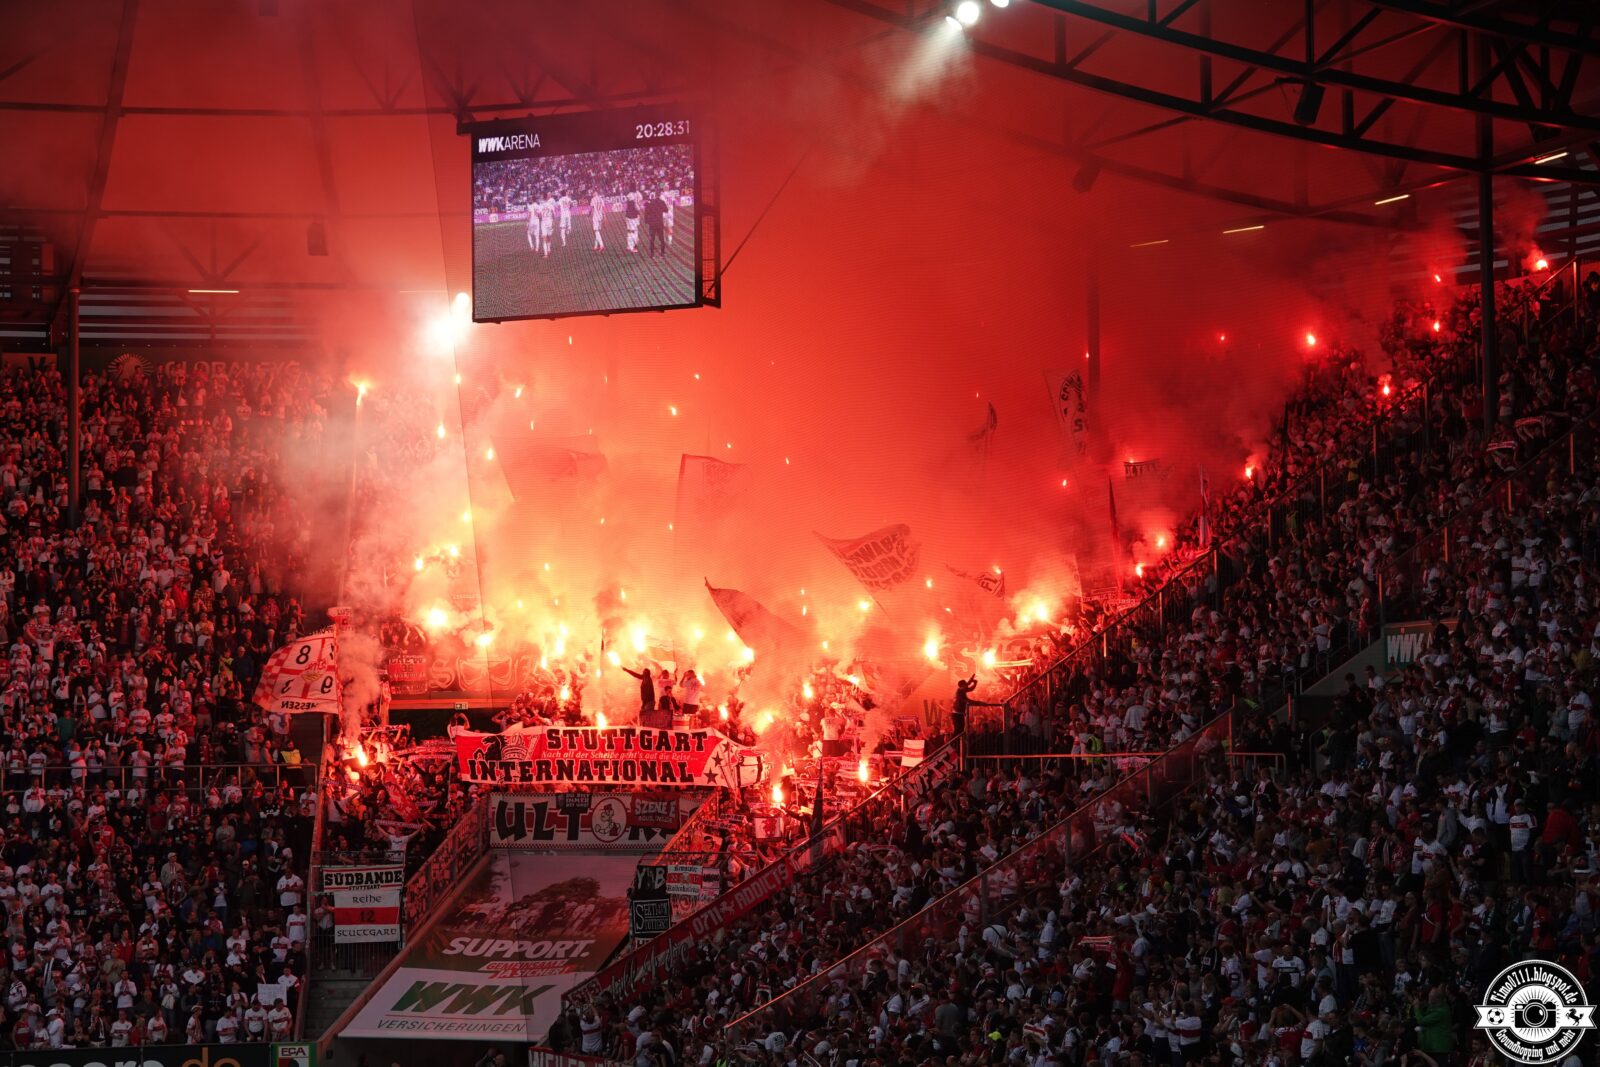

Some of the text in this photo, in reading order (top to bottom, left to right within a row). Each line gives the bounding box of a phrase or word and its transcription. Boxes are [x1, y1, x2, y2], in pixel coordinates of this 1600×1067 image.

[635, 120, 690, 139] 20:28:31
[546, 728, 708, 752] STUTTGART
[467, 759, 696, 782] INTERNATIONAL
[324, 870, 402, 886] SÜDBANDE
[692, 862, 789, 935] 0711 ADDICTS
[360, 910, 375, 922] 12
[390, 981, 557, 1015] WWK
[377, 1019, 527, 1033] VERSICHERUNGEN
